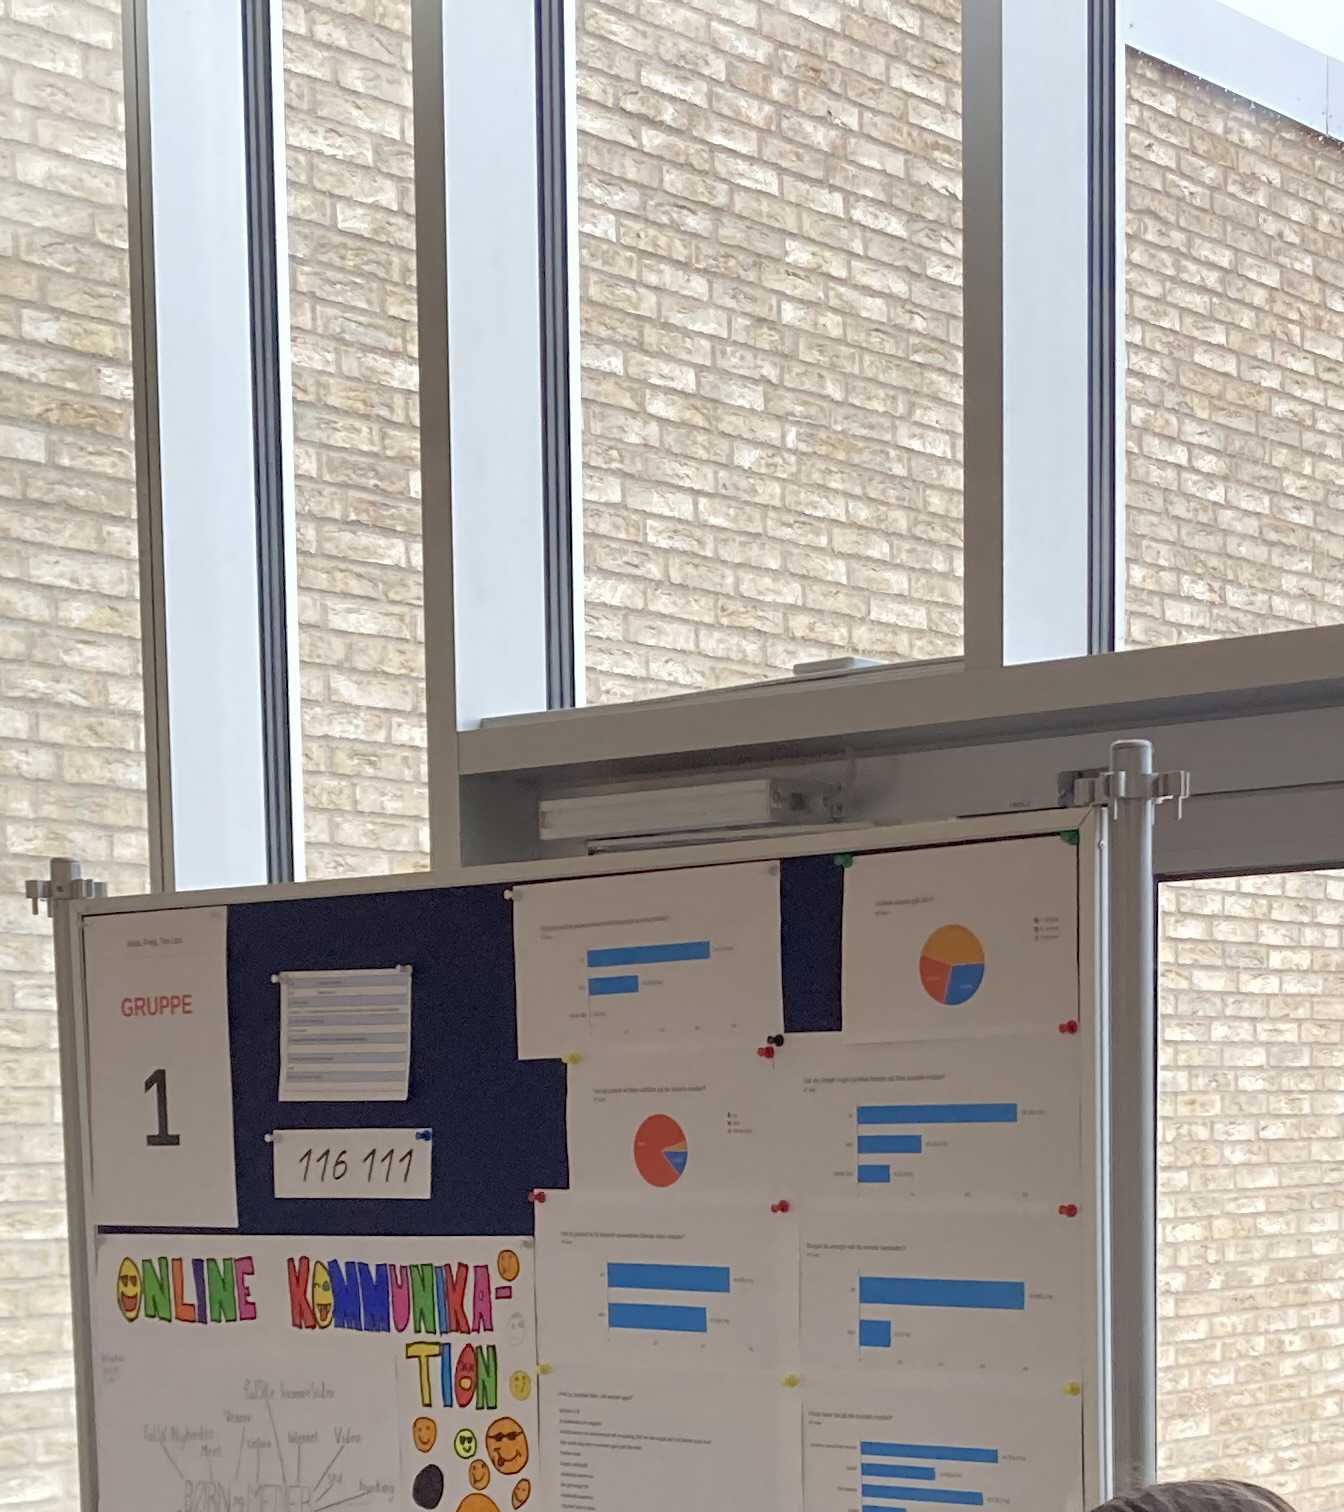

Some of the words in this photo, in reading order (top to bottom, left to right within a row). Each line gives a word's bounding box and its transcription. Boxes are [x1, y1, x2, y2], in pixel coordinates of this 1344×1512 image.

[120, 994, 193, 1018] GRUPPE
[143, 1068, 181, 1147] 1
[298, 1148, 348, 1183] 116
[362, 1148, 414, 1184] 111
[117, 1256, 257, 1324] ONLINE
[287, 1256, 512, 1336] KOMMUNIKA-
[405, 1341, 499, 1410] TION
